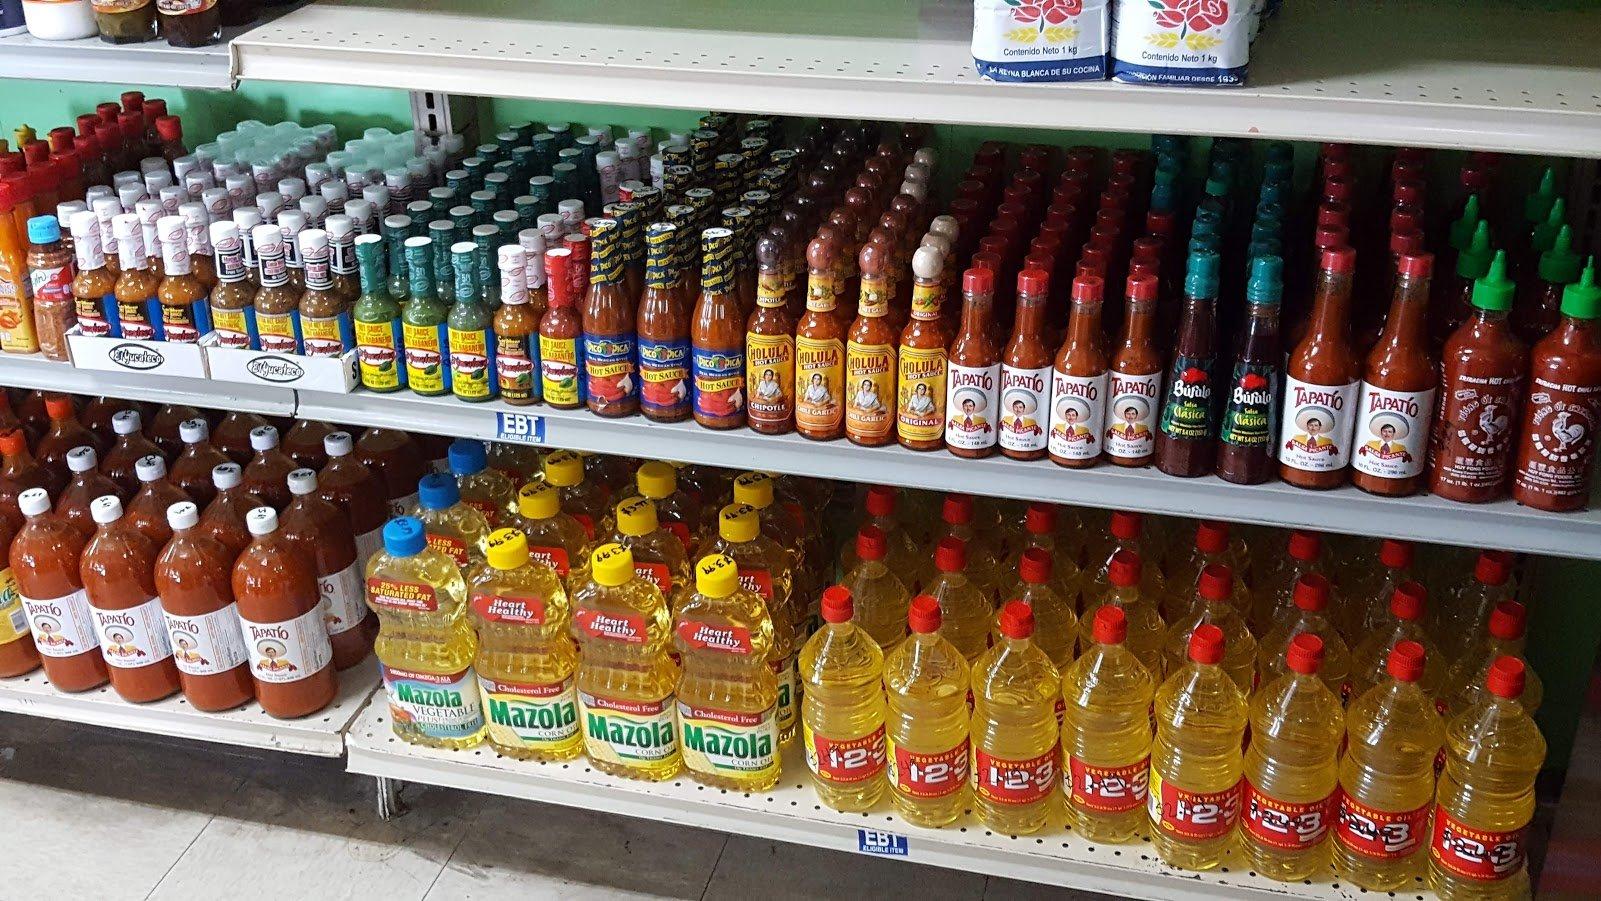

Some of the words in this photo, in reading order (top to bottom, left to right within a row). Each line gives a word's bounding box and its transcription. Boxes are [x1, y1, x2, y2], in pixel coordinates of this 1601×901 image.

[1003, 48, 1041, 56] Contenido
[1042, 46, 1060, 55] Neto
[1062, 45, 1066, 54] 1
[1068, 45, 1078, 55] kg
[1141, 51, 1179, 62] Contenido
[1181, 53, 1200, 62] Neto
[1207, 53, 1218, 64] kg
[1021, 68, 1049, 78] BLANCA
[1051, 67, 1061, 76] DE
[1062, 67, 1072, 75] SU
[1073, 65, 1100, 74] COCINA
[1158, 74, 1190, 82] FAMILIAR
[123, 348, 161, 364] Yucateco
[748, 344, 789, 361] CHOLULA
[797, 347, 838, 366] CHOLULA
[262, 360, 301, 378] Yucateco
[847, 353, 888, 371] CHOLULA
[900, 358, 943, 376] CHOLULA
[589, 366, 602, 376] HOT
[604, 364, 629, 375] SAUCE
[644, 372, 657, 381] HOT
[659, 370, 684, 380] SAUCE
[700, 381, 714, 390] HOT
[716, 380, 740, 389] SAUCE
[951, 369, 993, 391] TAPATÍO
[1002, 369, 1044, 393] TAPATÍO
[1111, 377, 1156, 398] TAPATÍO
[1055, 377, 1098, 401] TAPATÍO
[1173, 379, 1211, 399] Búfalo
[1233, 386, 1272, 405] Búfalo
[1562, 384, 1577, 393] HOT
[1294, 386, 1344, 411] TAPATÍO
[1368, 391, 1419, 418] TAPATÍO
[750, 402, 785, 412] CHIPOTLE
[1173, 404, 1205, 420] Clásica
[503, 413, 539, 436] EBT
[900, 416, 938, 426] ORIGINAL
[1234, 410, 1267, 426] Clásica
[500, 432, 527, 441] ELIGIBLE
[527, 435, 542, 443] ITEM
[1291, 439, 1307, 450] SALSA
[1309, 444, 1333, 454] PICANTE
[1365, 445, 1380, 457] SALSA
[1382, 451, 1406, 460] PICANTE
[433, 539, 452, 547] LESS
[448, 547, 464, 555] FAT
[529, 551, 551, 559] eart
[702, 555, 732, 575] $3.99
[370, 586, 415, 599] SATURATED
[416, 593, 431, 601] FAT
[400, 584, 419, 593] LESS
[25, 601, 62, 617] TAPATÍO
[493, 598, 526, 608] Heart
[488, 605, 534, 618] Healthy
[96, 612, 135, 627] TAPATÍO
[165, 615, 200, 635] TAPATÍO
[596, 615, 629, 627] Heart
[250, 625, 289, 640] TAPATÍO
[590, 622, 637, 637] Healthy
[700, 626, 733, 638] Heart
[693, 633, 741, 648] Healthy
[397, 682, 463, 708] Mazola
[497, 684, 542, 695] Cholesterol
[543, 686, 560, 694] Free
[413, 702, 474, 718] VEGETABLE
[596, 698, 641, 712] Cholesterol
[642, 704, 660, 713] Free
[488, 698, 576, 730] Mazola
[694, 709, 739, 723] Cholesterol
[740, 716, 758, 724] Free
[538, 729, 563, 737] CORN
[587, 712, 674, 748] Mazola
[684, 722, 772, 759] Mazola
[635, 748, 662, 757] CORN
[731, 758, 758, 767] CORN
[989, 758, 1041, 770] VEGETABLE
[1085, 765, 1137, 778] VEGETABLE
[1251, 790, 1304, 813] VEGETABLE
[1309, 803, 1323, 812] OIL
[1342, 794, 1391, 822] VEGETABLE
[1446, 819, 1501, 842] VEGETABLE
[865, 830, 898, 848] EBT
[862, 845, 889, 853] ELIGIBLE
